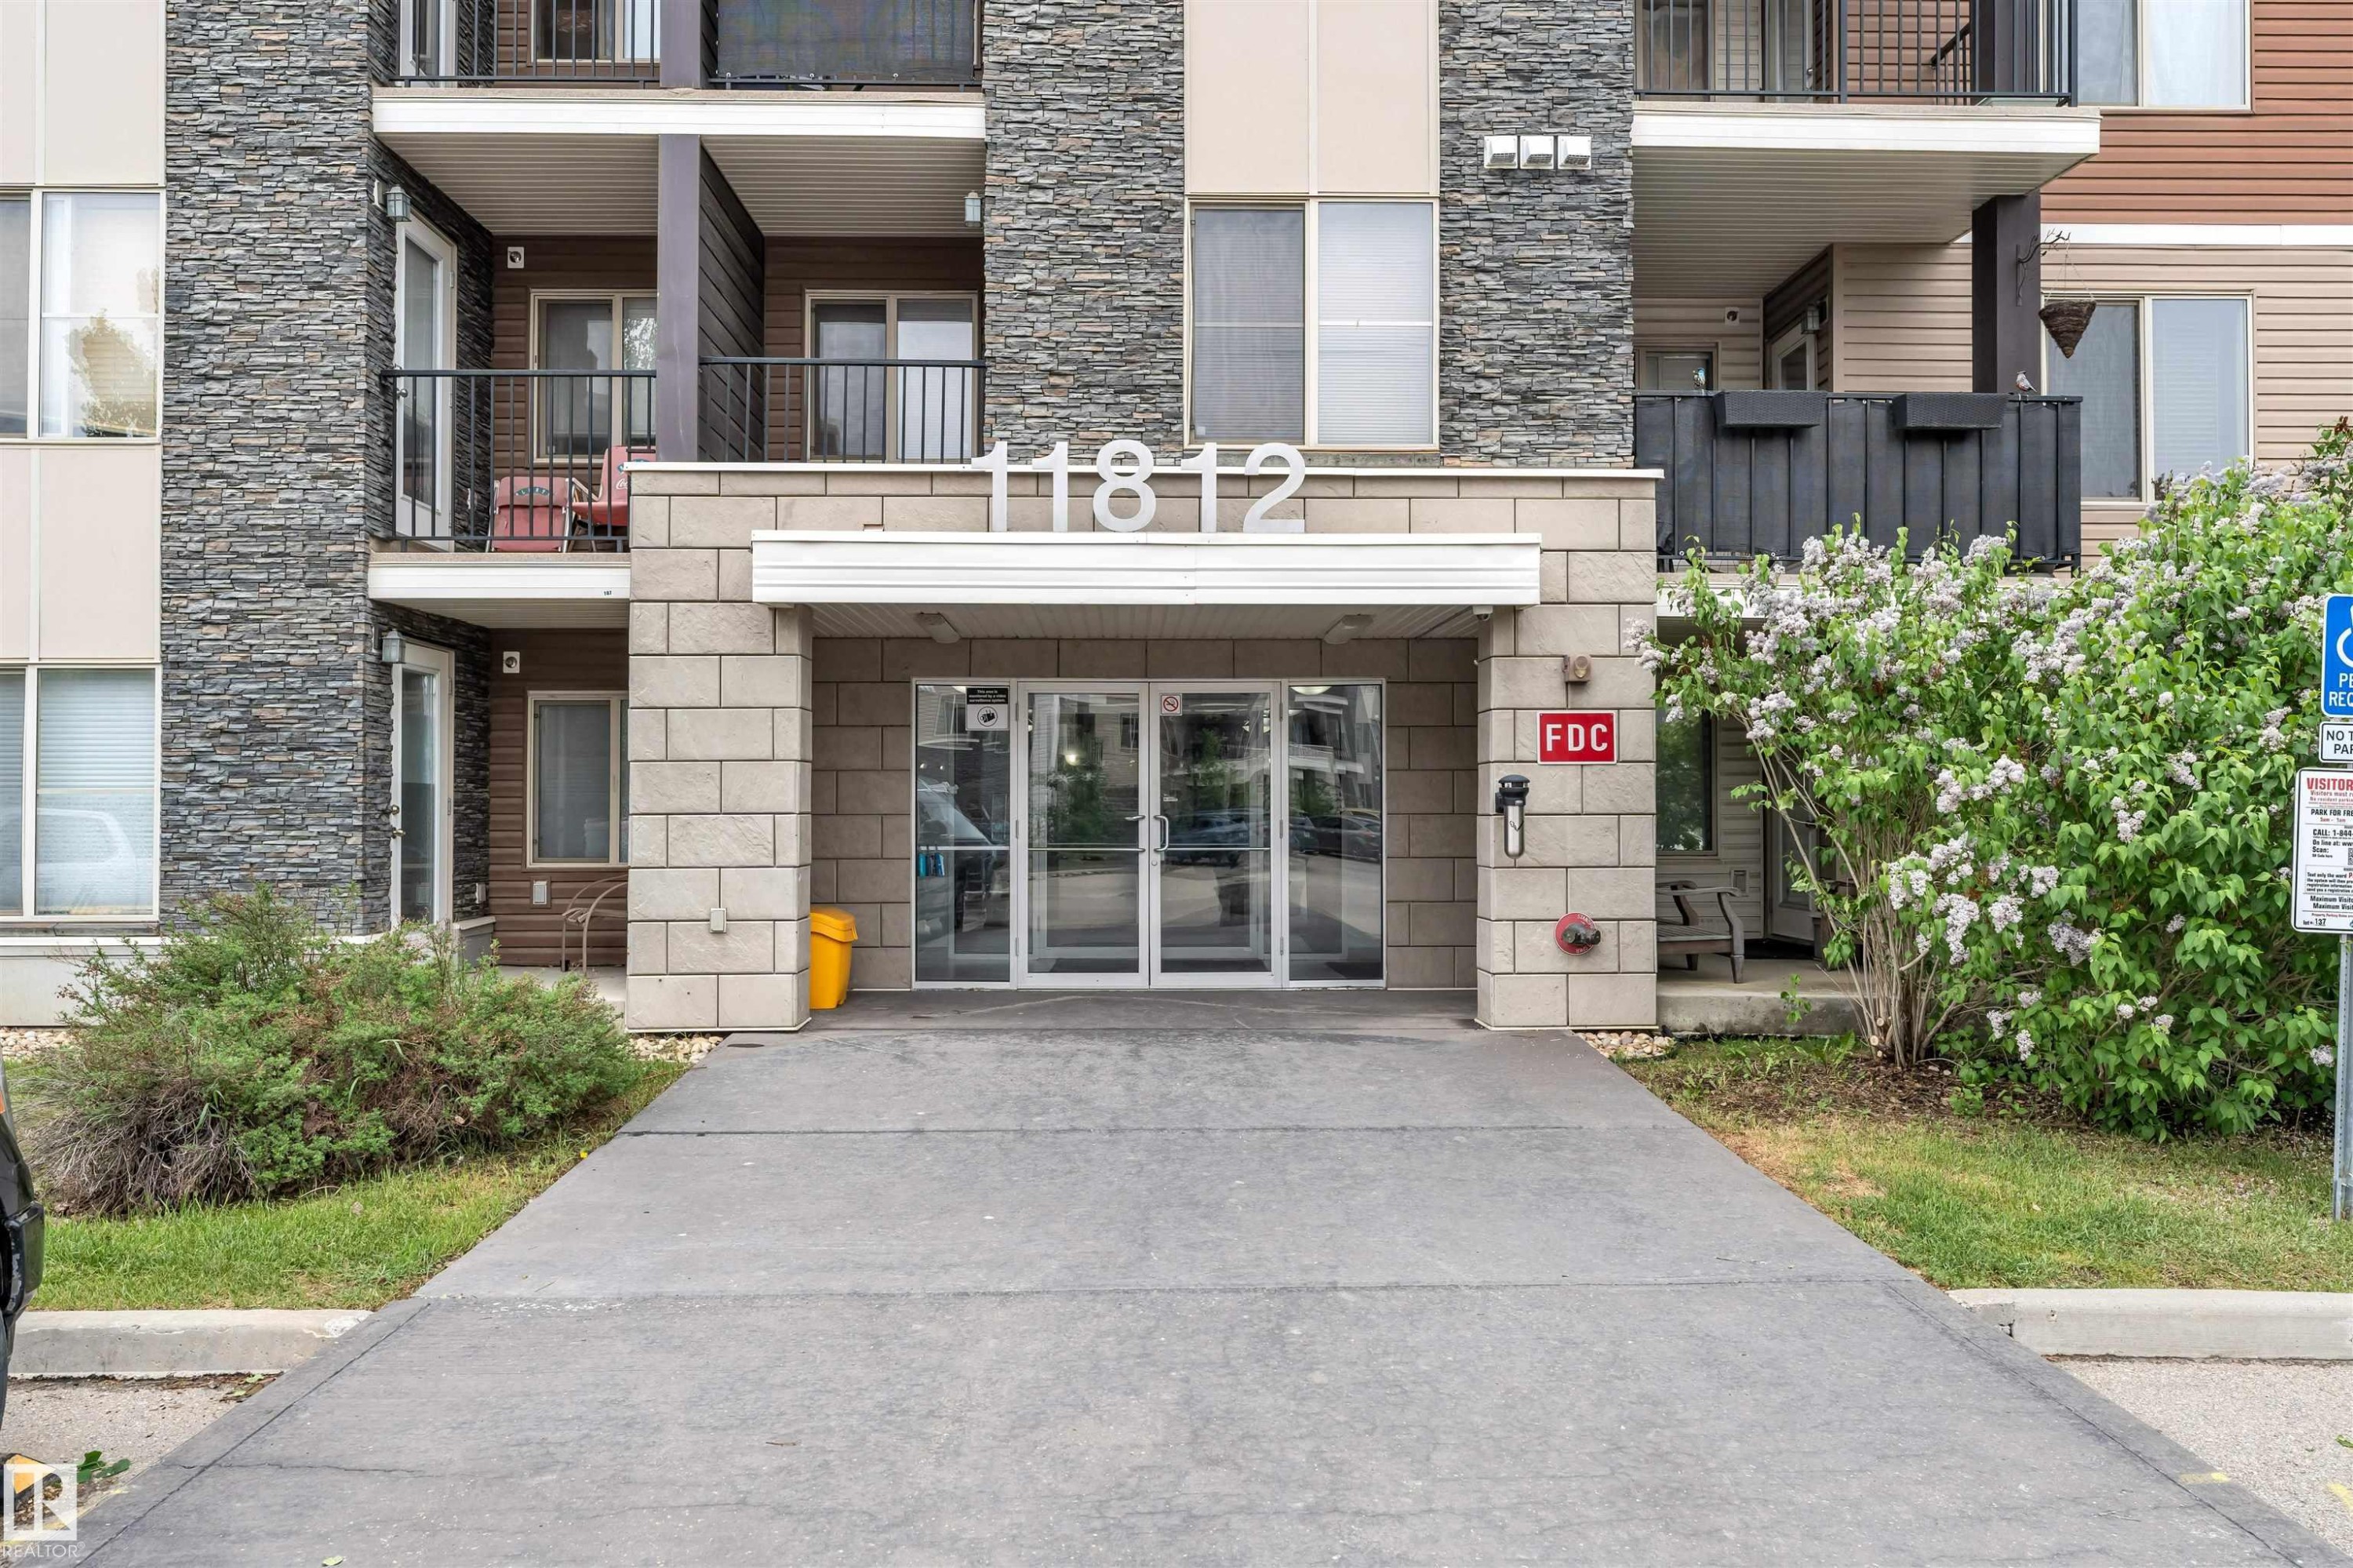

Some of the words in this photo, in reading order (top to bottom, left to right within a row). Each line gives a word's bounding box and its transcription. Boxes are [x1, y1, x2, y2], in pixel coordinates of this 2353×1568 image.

[971, 439, 1306, 533] 11812
[1546, 723, 1608, 751] FDC
[2326, 730, 2344, 740] NO
